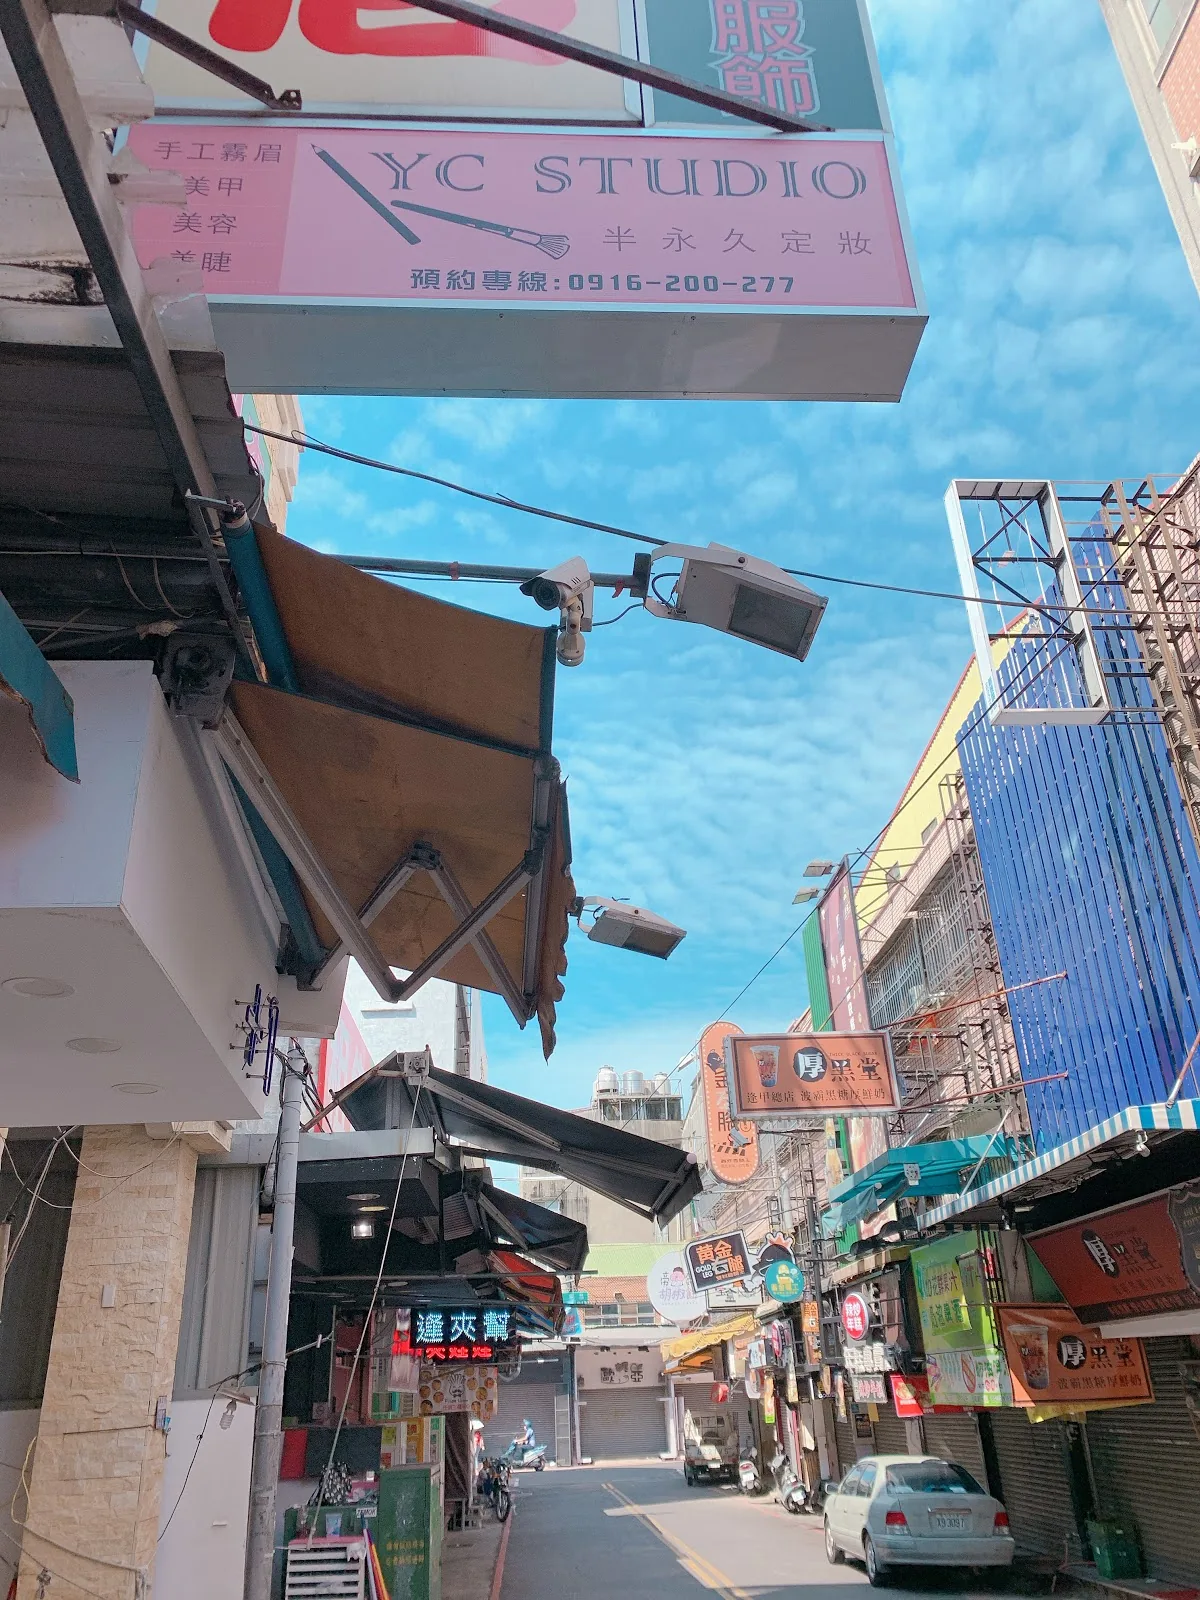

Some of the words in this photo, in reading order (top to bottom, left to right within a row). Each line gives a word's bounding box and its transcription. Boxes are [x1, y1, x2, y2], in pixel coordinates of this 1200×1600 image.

[153, 140, 282, 164] 手工霧眉
[183, 175, 244, 198] 美甲
[369, 152, 485, 192] YC
[534, 155, 867, 200] STUDIO
[172, 212, 238, 236] 美容
[695, 1263, 712, 1274] GOLD
[702, 1270, 714, 1279] LEG
